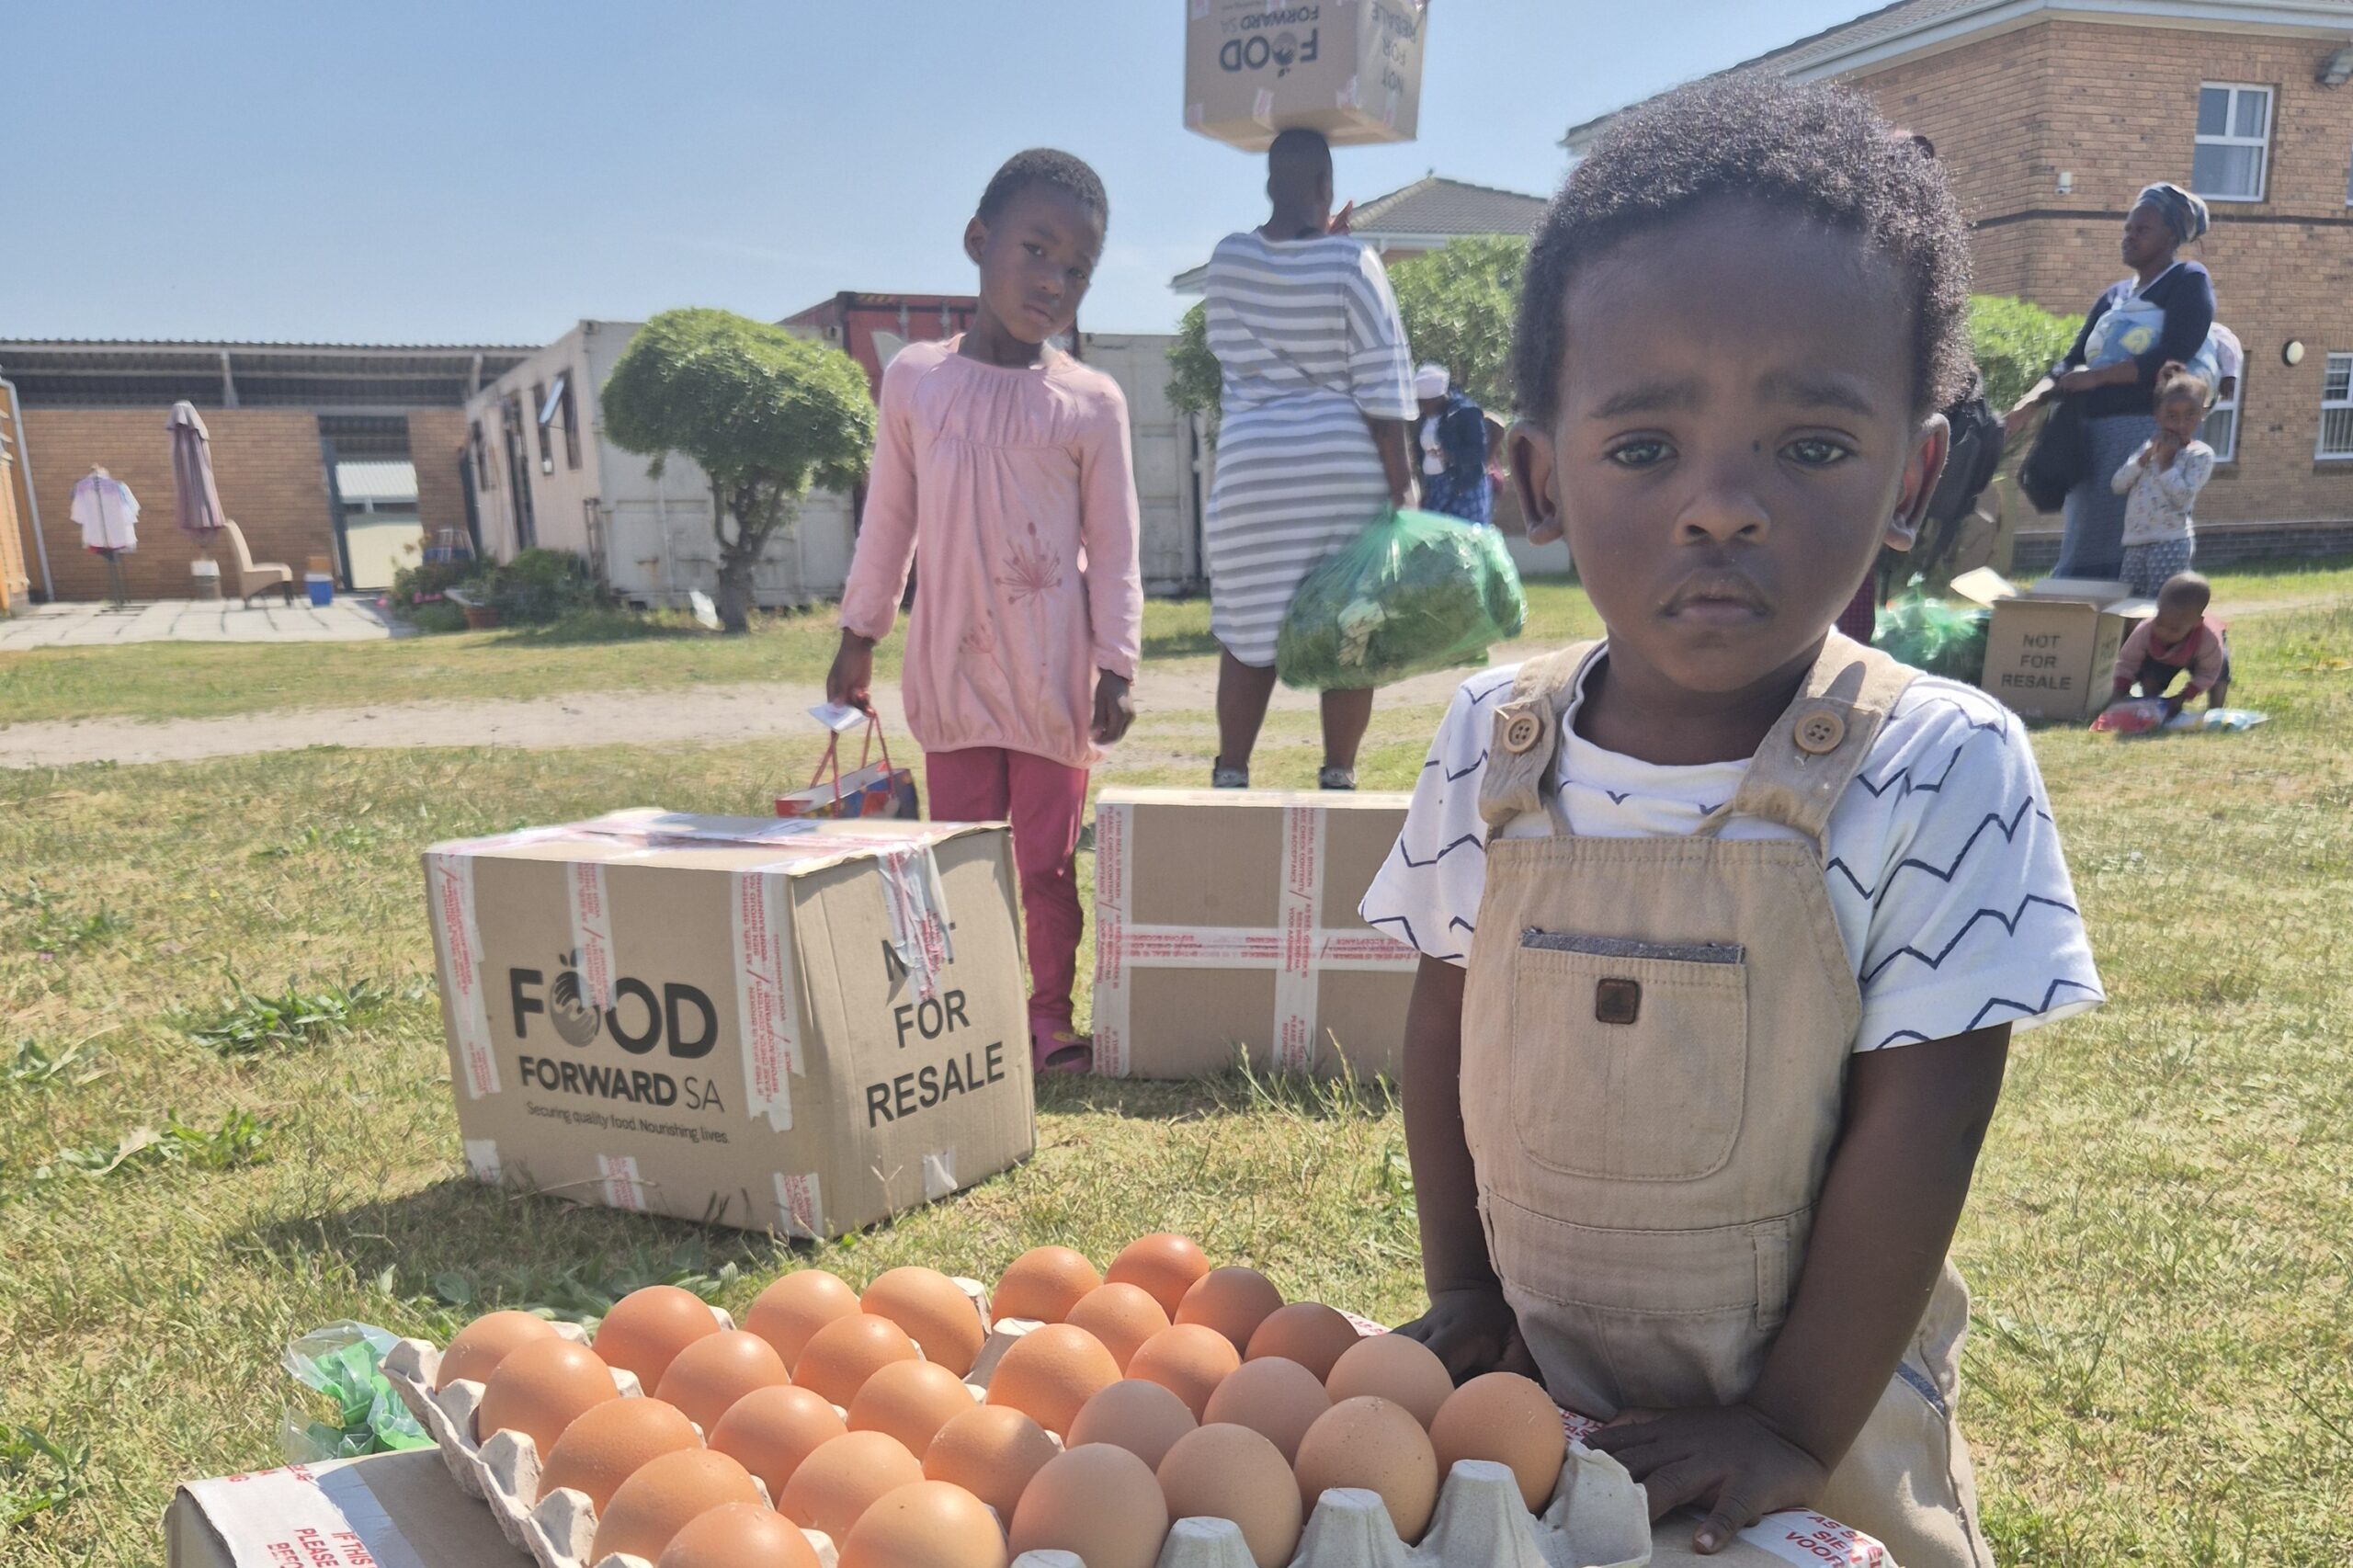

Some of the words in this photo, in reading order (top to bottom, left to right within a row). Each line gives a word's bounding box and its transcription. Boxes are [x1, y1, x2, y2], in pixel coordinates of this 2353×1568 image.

[1241, 6, 1320, 31] FORWARD
[1219, 28, 1319, 74] FOOD
[2023, 634, 2061, 649] NOT
[2021, 654, 2057, 668] FOR
[2001, 673, 2073, 689] RESALE
[509, 968, 719, 1059] FOOD
[893, 989, 971, 1049] FOR
[519, 1056, 677, 1107] FORWARD
[684, 1077, 725, 1113] SA
[866, 1040, 1006, 1129] RESALE
[527, 1101, 571, 1125] Securing
[573, 1111, 608, 1130] quality
[640, 1119, 699, 1143] Nourishing
[332, 1532, 356, 1540] IF
[1807, 1516, 1841, 1529] AS
[294, 1528, 340, 1567] PLEASE
[340, 1542, 373, 1565] THIS
